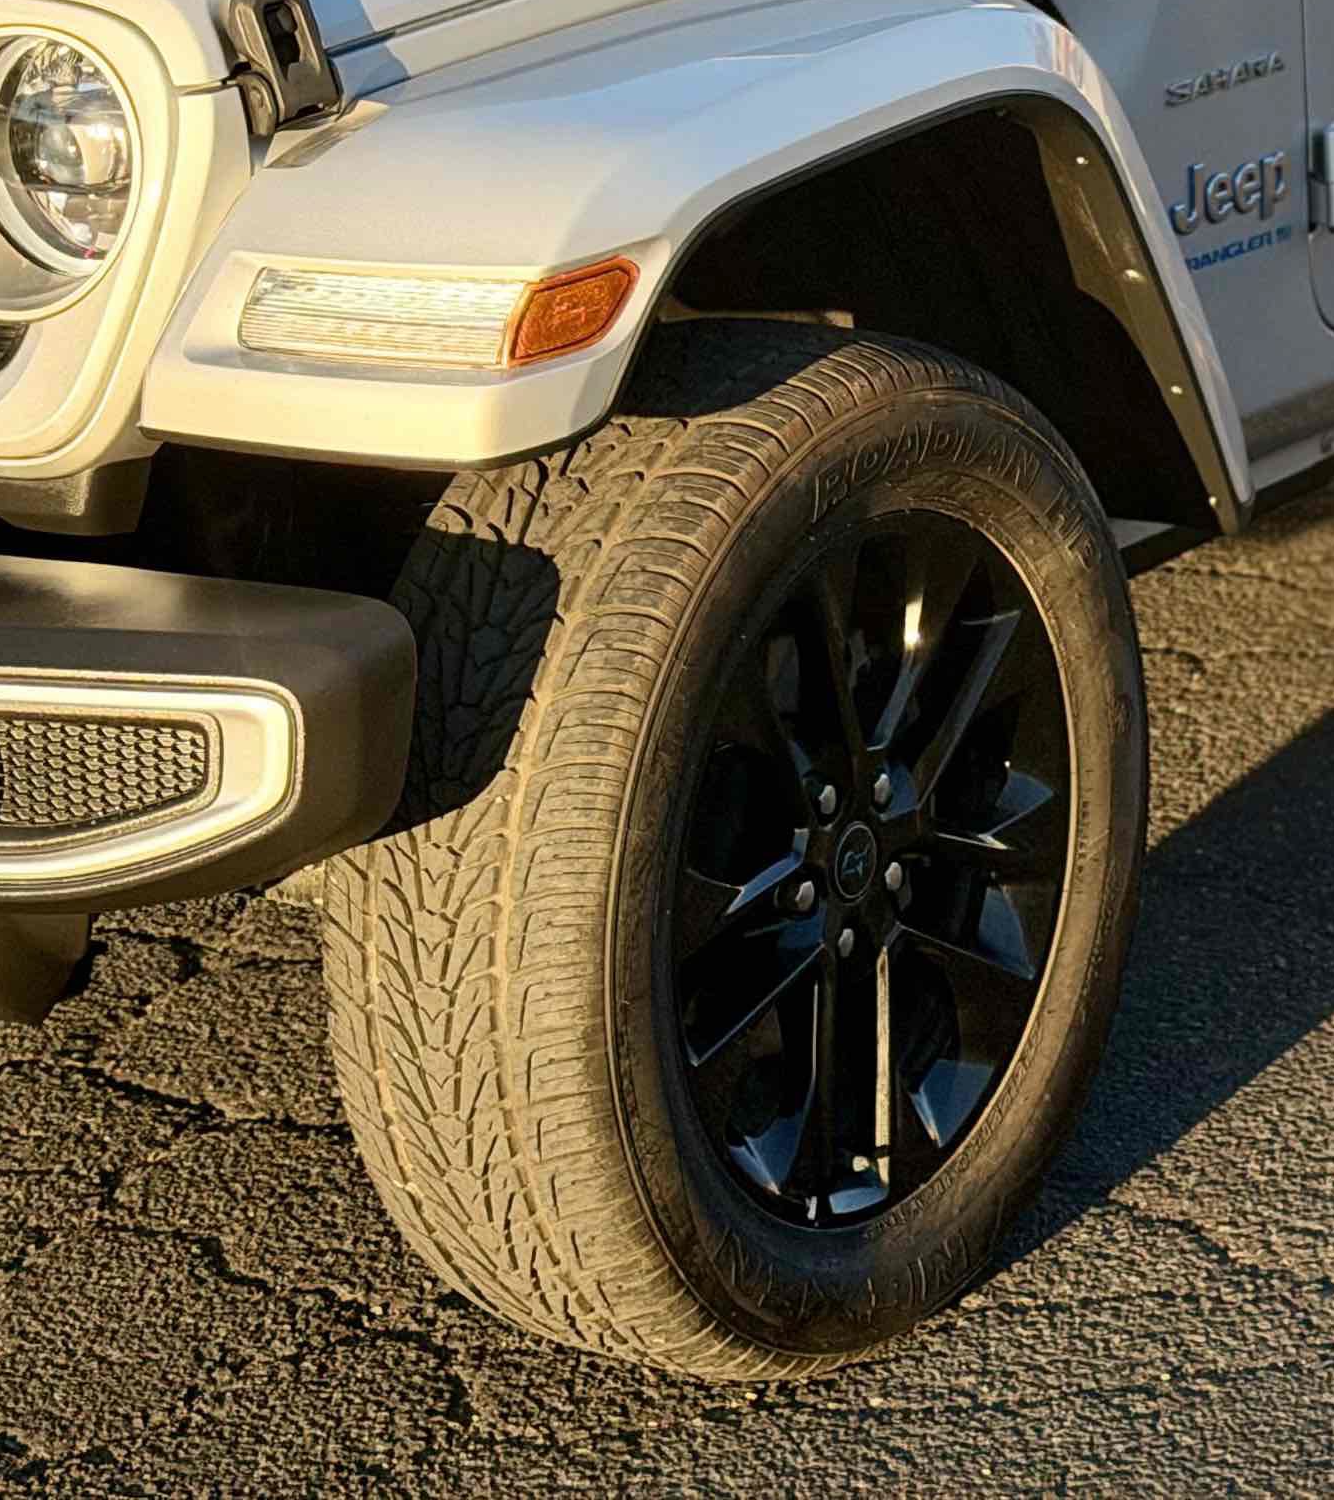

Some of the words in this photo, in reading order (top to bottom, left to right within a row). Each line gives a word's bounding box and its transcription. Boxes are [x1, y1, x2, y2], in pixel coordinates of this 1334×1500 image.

[1164, 51, 1285, 107] SAHARA
[1169, 150, 1286, 236] Jeep
[811, 418, 1042, 526] ROADIAN
